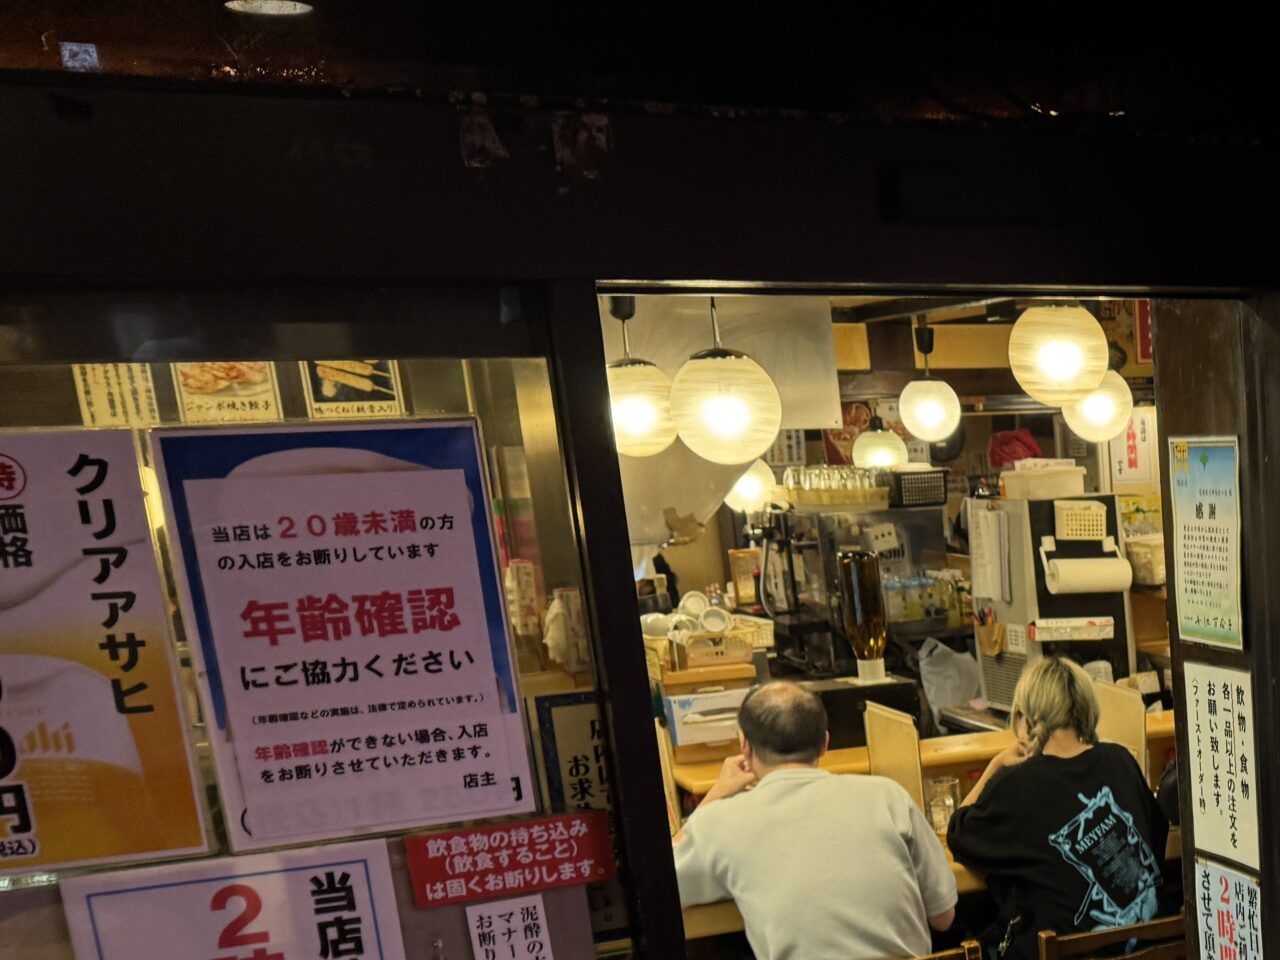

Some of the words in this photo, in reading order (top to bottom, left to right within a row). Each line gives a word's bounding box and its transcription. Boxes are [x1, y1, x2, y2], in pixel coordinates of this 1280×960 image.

[218, 543, 439, 571] の入店をお断りしています
[67, 454, 154, 715] クリアアサヒ
[240, 587, 461, 646] 年齢確認
[240, 650, 474, 690] にご協力ください
[260, 745, 491, 784] をお断りさせていただきます。
[1206, 679, 1224, 816] お願い致します。
[1221, 682, 1238, 849] 各一品以上の注文を
[463, 771, 497, 790] 店主
[426, 819, 588, 858] 飲食物の持ち込み
[445, 841, 577, 875] (飲食すること)
[425, 859, 605, 901] は固くお断りします。
